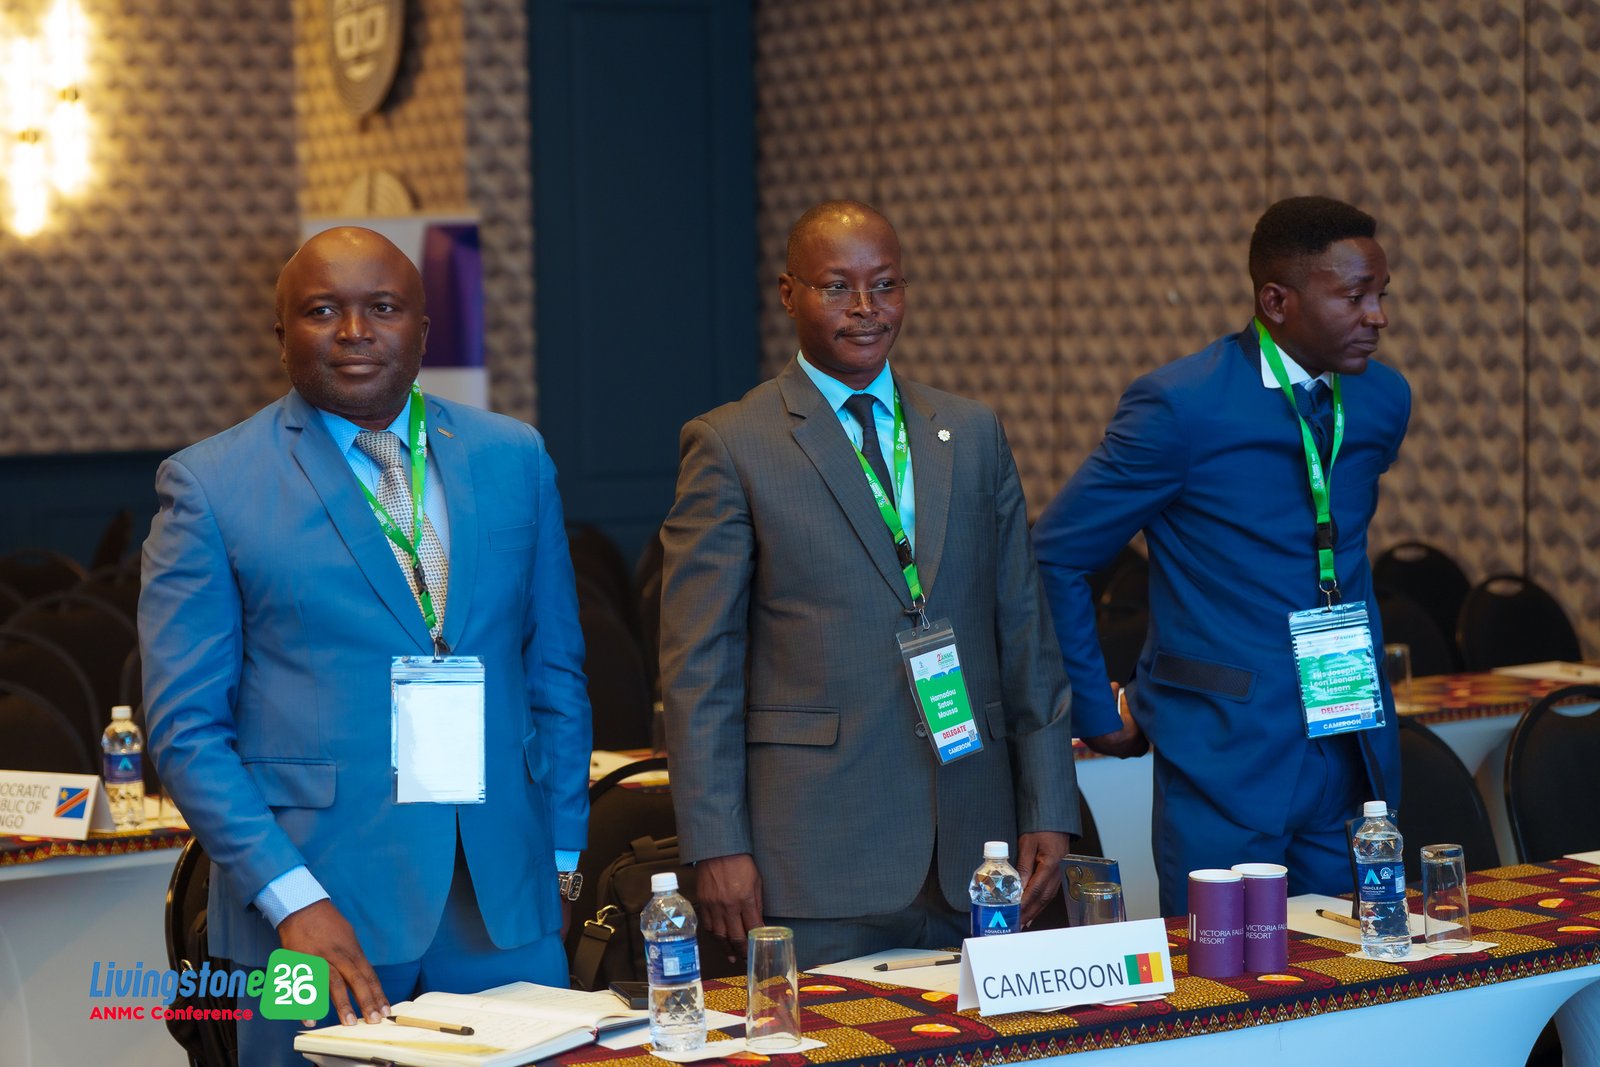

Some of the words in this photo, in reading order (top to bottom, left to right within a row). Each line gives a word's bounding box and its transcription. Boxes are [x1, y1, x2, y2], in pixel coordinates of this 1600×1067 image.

[930, 689, 957, 703] Hamadou
[938, 700, 953, 709] Satou
[1321, 703, 1359, 714] DELEGATE
[938, 707, 958, 718] Moussa
[1323, 719, 1361, 729] CAMEROON
[942, 725, 967, 739] DELEGATE
[948, 742, 972, 754] CAMEROON
[25, 800, 41, 815] OF
[1199, 928, 1232, 937] VICTORIA
[1245, 923, 1277, 932] VICTORIA
[1199, 936, 1226, 945] RESORT
[1245, 931, 1272, 940] RESORT
[983, 962, 1124, 1000] CAMEROON
